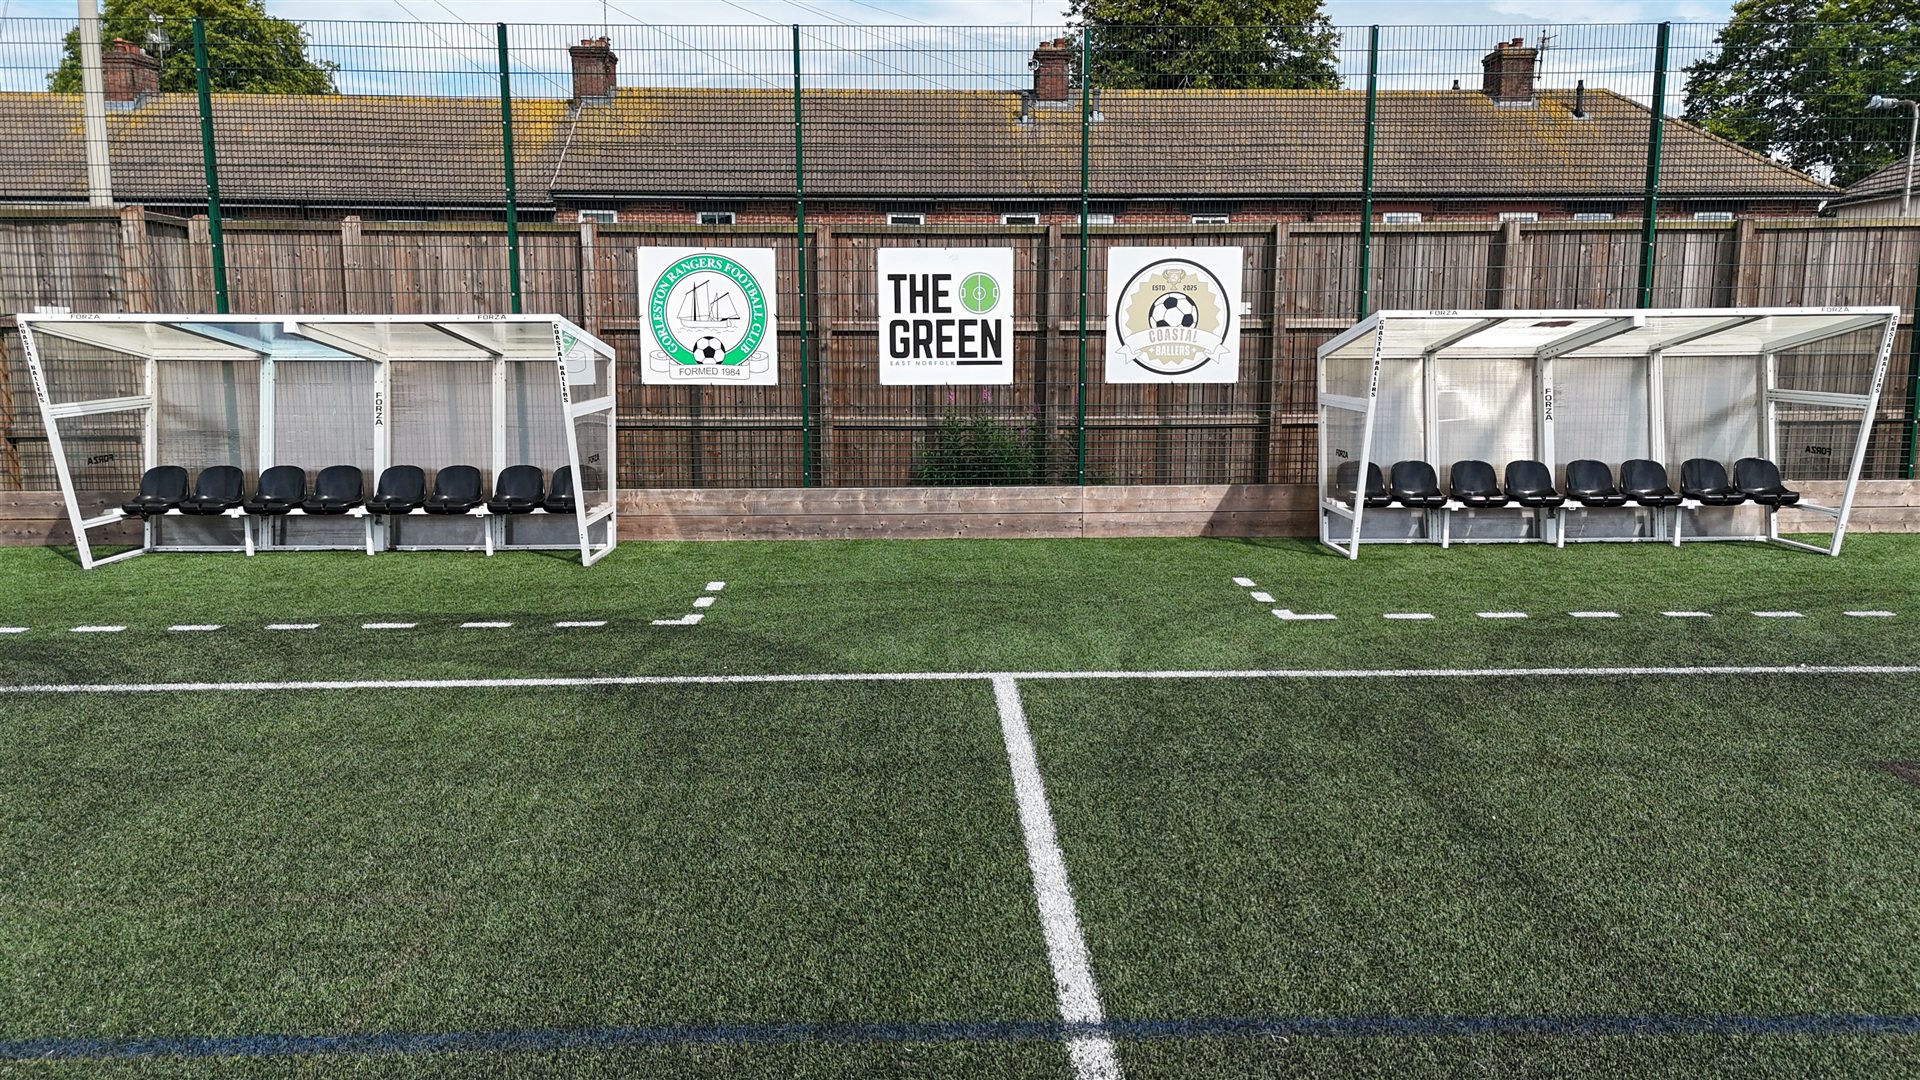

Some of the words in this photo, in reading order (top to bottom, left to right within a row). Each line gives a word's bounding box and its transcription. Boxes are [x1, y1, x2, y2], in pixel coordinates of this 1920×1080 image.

[666, 258, 723, 284] RANGERS
[724, 263, 764, 321] FOOTBALL
[887, 273, 952, 314] THE
[652, 281, 678, 353] GORLESTON
[1148, 328, 1198, 343] COASTAL
[1885, 315, 1898, 354] COASTAL
[19, 323, 33, 362] COASTAL
[740, 322, 762, 354] CLUB
[889, 319, 1002, 359] GREEN
[1154, 344, 1191, 356] BALLERS
[1376, 319, 1385, 358] COASTAL
[553, 323, 563, 363] COASTAL
[559, 365, 569, 403] BALLERS
[679, 367, 718, 376] FORMED
[721, 367, 741, 376] 1984
[1371, 360, 1380, 397] BALLERS
[375, 391, 384, 425] FORZA
[1544, 387, 1553, 421] FORZA
